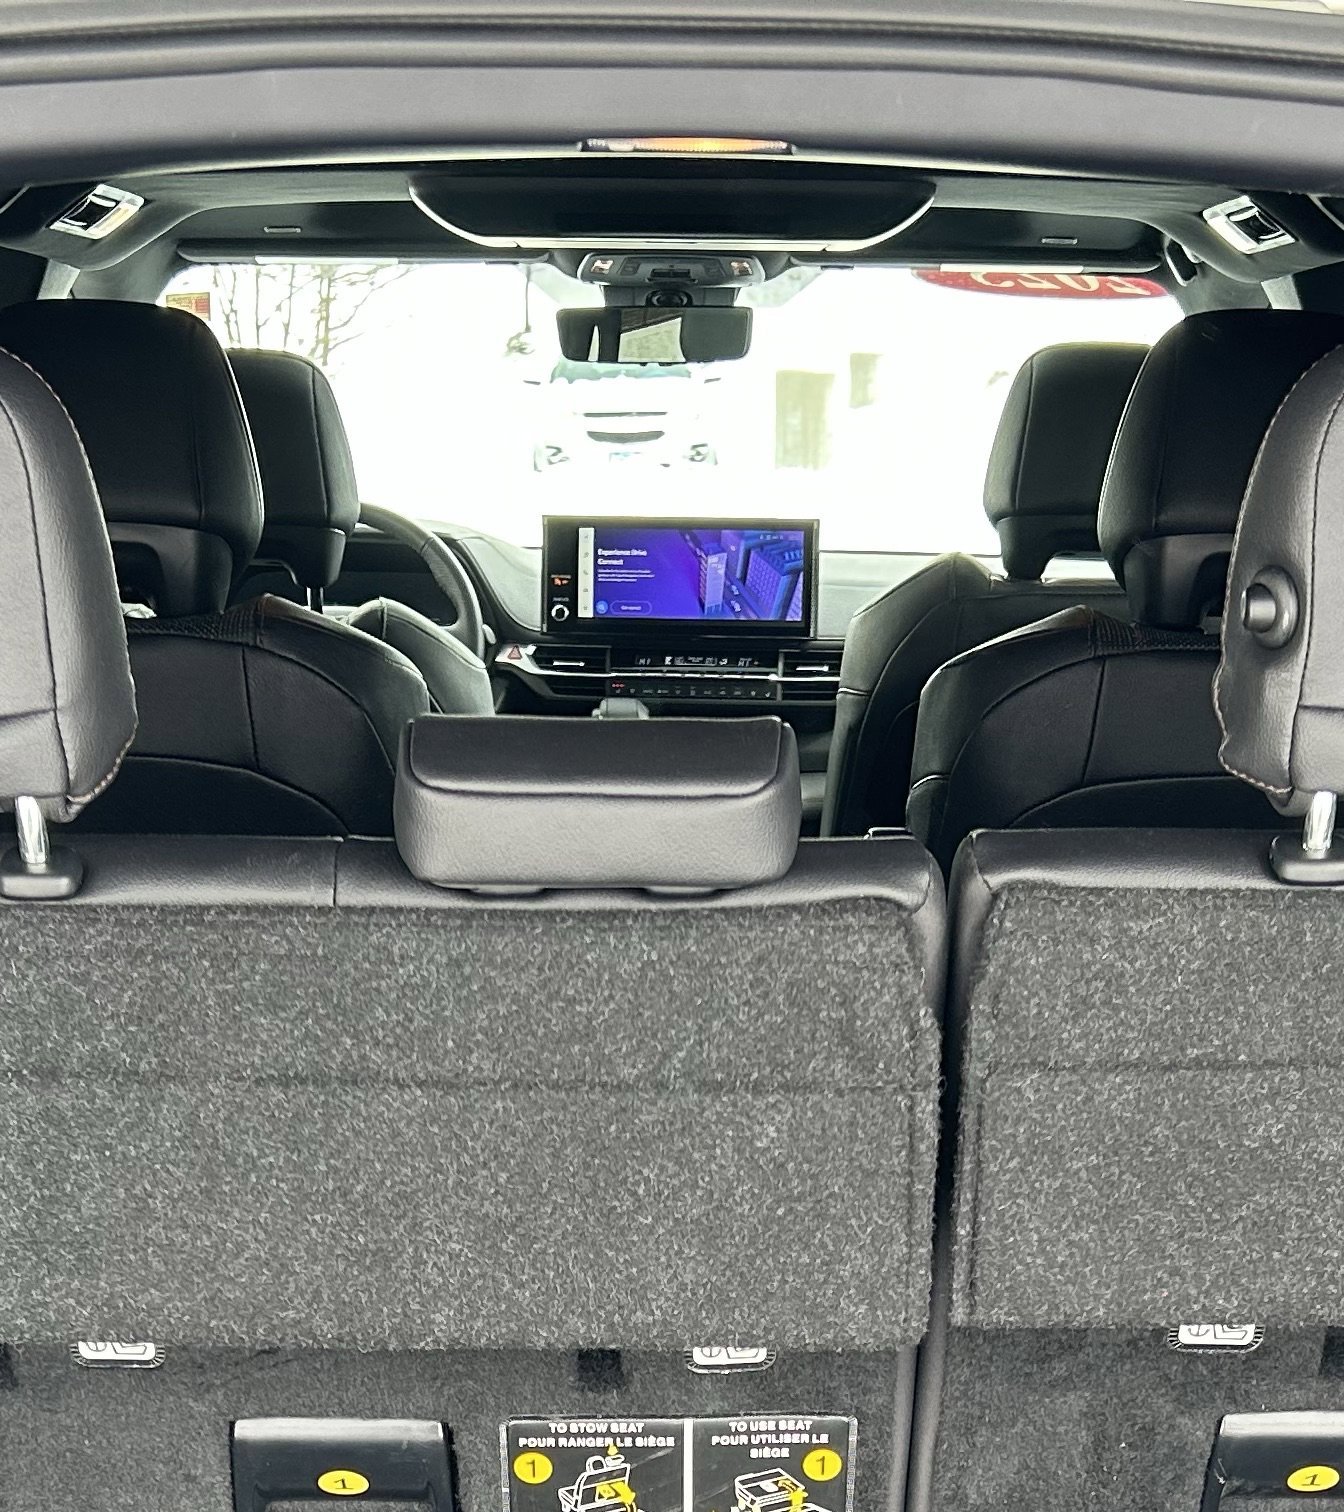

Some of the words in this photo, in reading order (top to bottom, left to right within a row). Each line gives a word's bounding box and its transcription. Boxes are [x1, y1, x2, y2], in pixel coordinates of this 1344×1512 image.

[548, 1422, 568, 1434] TO
[569, 1422, 609, 1434] STOW
[610, 1422, 645, 1433] SEAT
[728, 1421, 748, 1432] TO
[749, 1420, 776, 1432] USE
[778, 1420, 813, 1431] SEAT
[518, 1437, 556, 1448] POUR
[558, 1436, 613, 1448] RANGER
[615, 1436, 633, 1447] LE
[711, 1435, 749, 1446] POUR
[750, 1433, 810, 1445] UTILISER
[811, 1433, 830, 1444] LE
[526, 1458, 536, 1478] 1
[815, 1455, 826, 1475] 1
